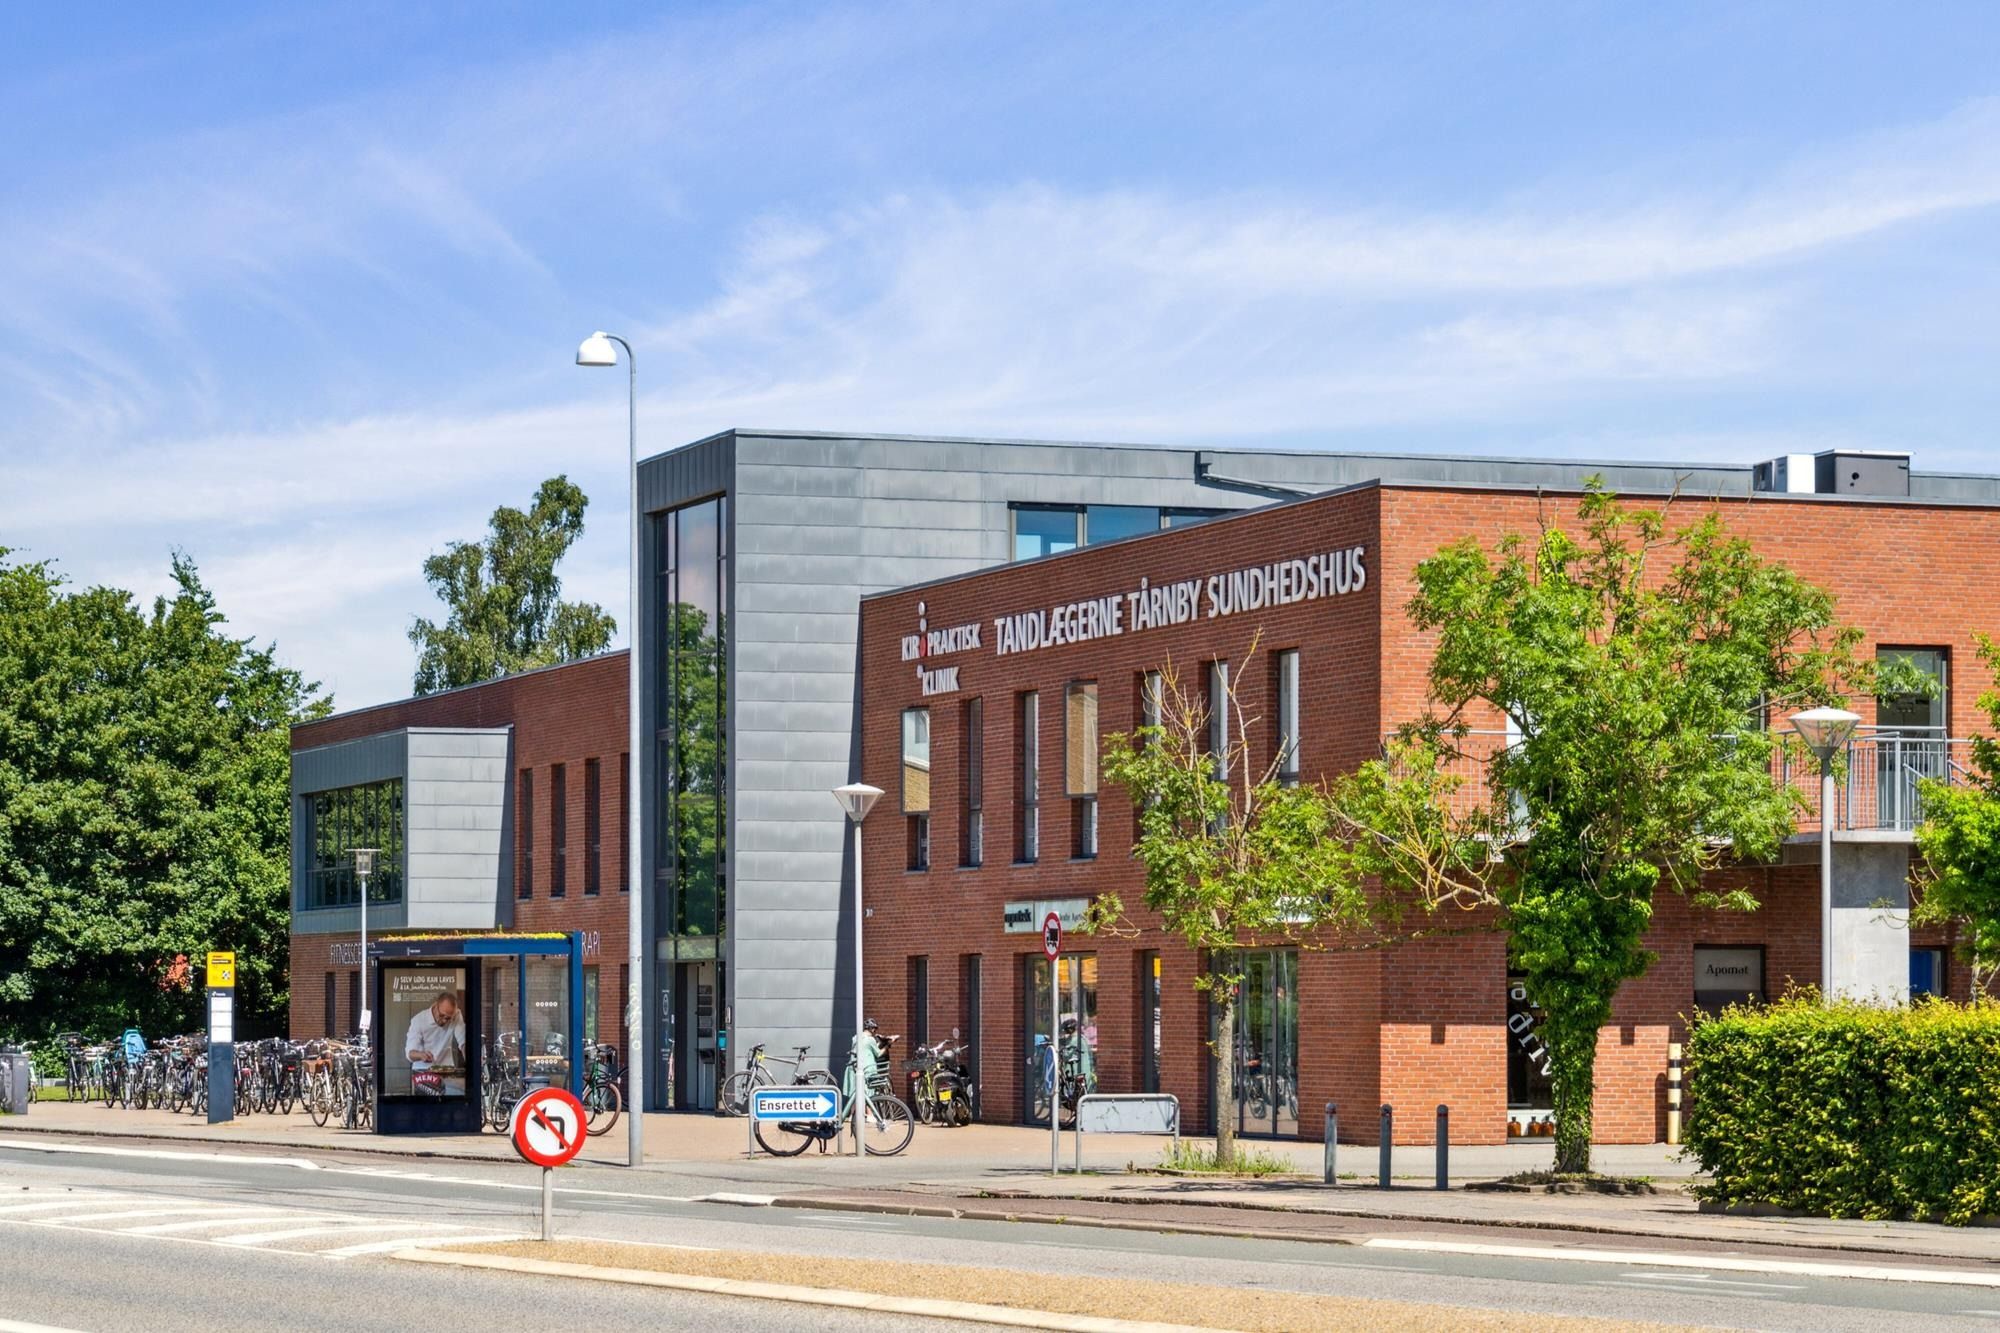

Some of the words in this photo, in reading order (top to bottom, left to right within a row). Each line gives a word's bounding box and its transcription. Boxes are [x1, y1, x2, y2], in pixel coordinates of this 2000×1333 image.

[994, 594, 1124, 656] TANDLÆGERNE
[1127, 576, 1203, 632] TÅRNBY
[1207, 546, 1367, 619] SUNDHEDSHUS
[922, 666, 960, 697] KLINIK
[1706, 964, 1749, 977] Apomat
[415, 1074, 438, 1083] MENY
[759, 1099, 817, 1111] Ensrettet
